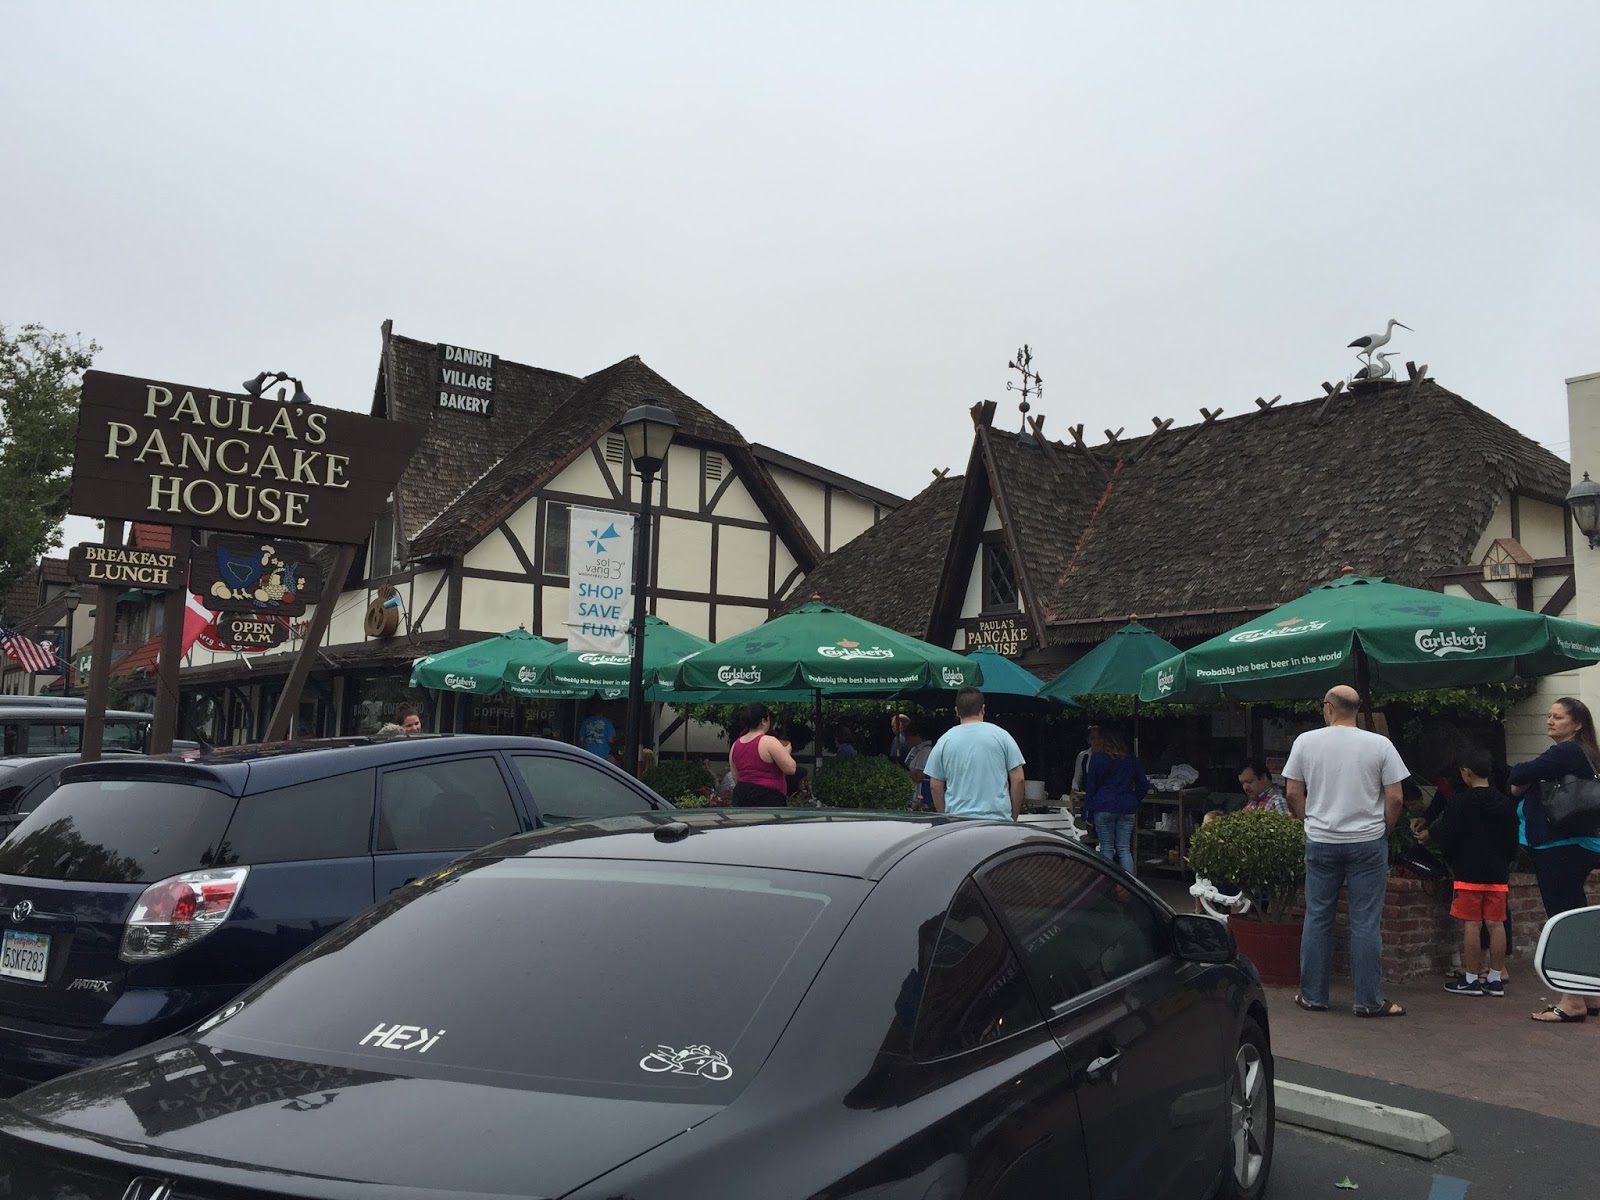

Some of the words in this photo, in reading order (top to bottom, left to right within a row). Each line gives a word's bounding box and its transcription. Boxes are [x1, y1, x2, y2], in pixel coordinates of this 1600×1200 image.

[445, 345, 492, 368] DANISH
[442, 368, 493, 391] VILLAGE
[440, 391, 490, 414] BAKERY
[144, 384, 328, 445] PAULA'S
[104, 421, 350, 489] PANCAKE
[147, 474, 310, 527] HOUSE
[85, 547, 177, 568] BREAKFAST
[88, 563, 169, 584] LUNCH
[579, 582, 624, 600] SHOP
[578, 602, 621, 619] SAVE
[231, 620, 276, 635] OPEN
[581, 622, 616, 637] FUN
[980, 619, 1015, 631] PAULA'S
[1228, 620, 1331, 643] Carlsberg
[233, 633, 243, 642] 6
[968, 628, 1028, 645] PANCAKE
[1414, 627, 1487, 657] Carlsberg
[577, 653, 631, 665] Carlsber
[817, 646, 894, 661] Carlsberg
[1196, 666, 1236, 678] Probably
[1236, 664, 1250, 673] the
[1250, 661, 1269, 671] best
[1271, 659, 1290, 668] beer
[1291, 657, 1300, 666] in
[1302, 655, 1317, 664] the
[1318, 651, 1342, 662] world
[444, 673, 477, 689] Carlsberg
[555, 675, 580, 684] Probably
[717, 665, 763, 686] Carlsberg
[849, 676, 862, 684] best
[864, 676, 878, 684] beer
[899, 675, 918, 683] world
[473, 707, 515, 718] COFFEE
[526, 708, 556, 719] SHOP
[66, 978, 112, 992] MATRIX
